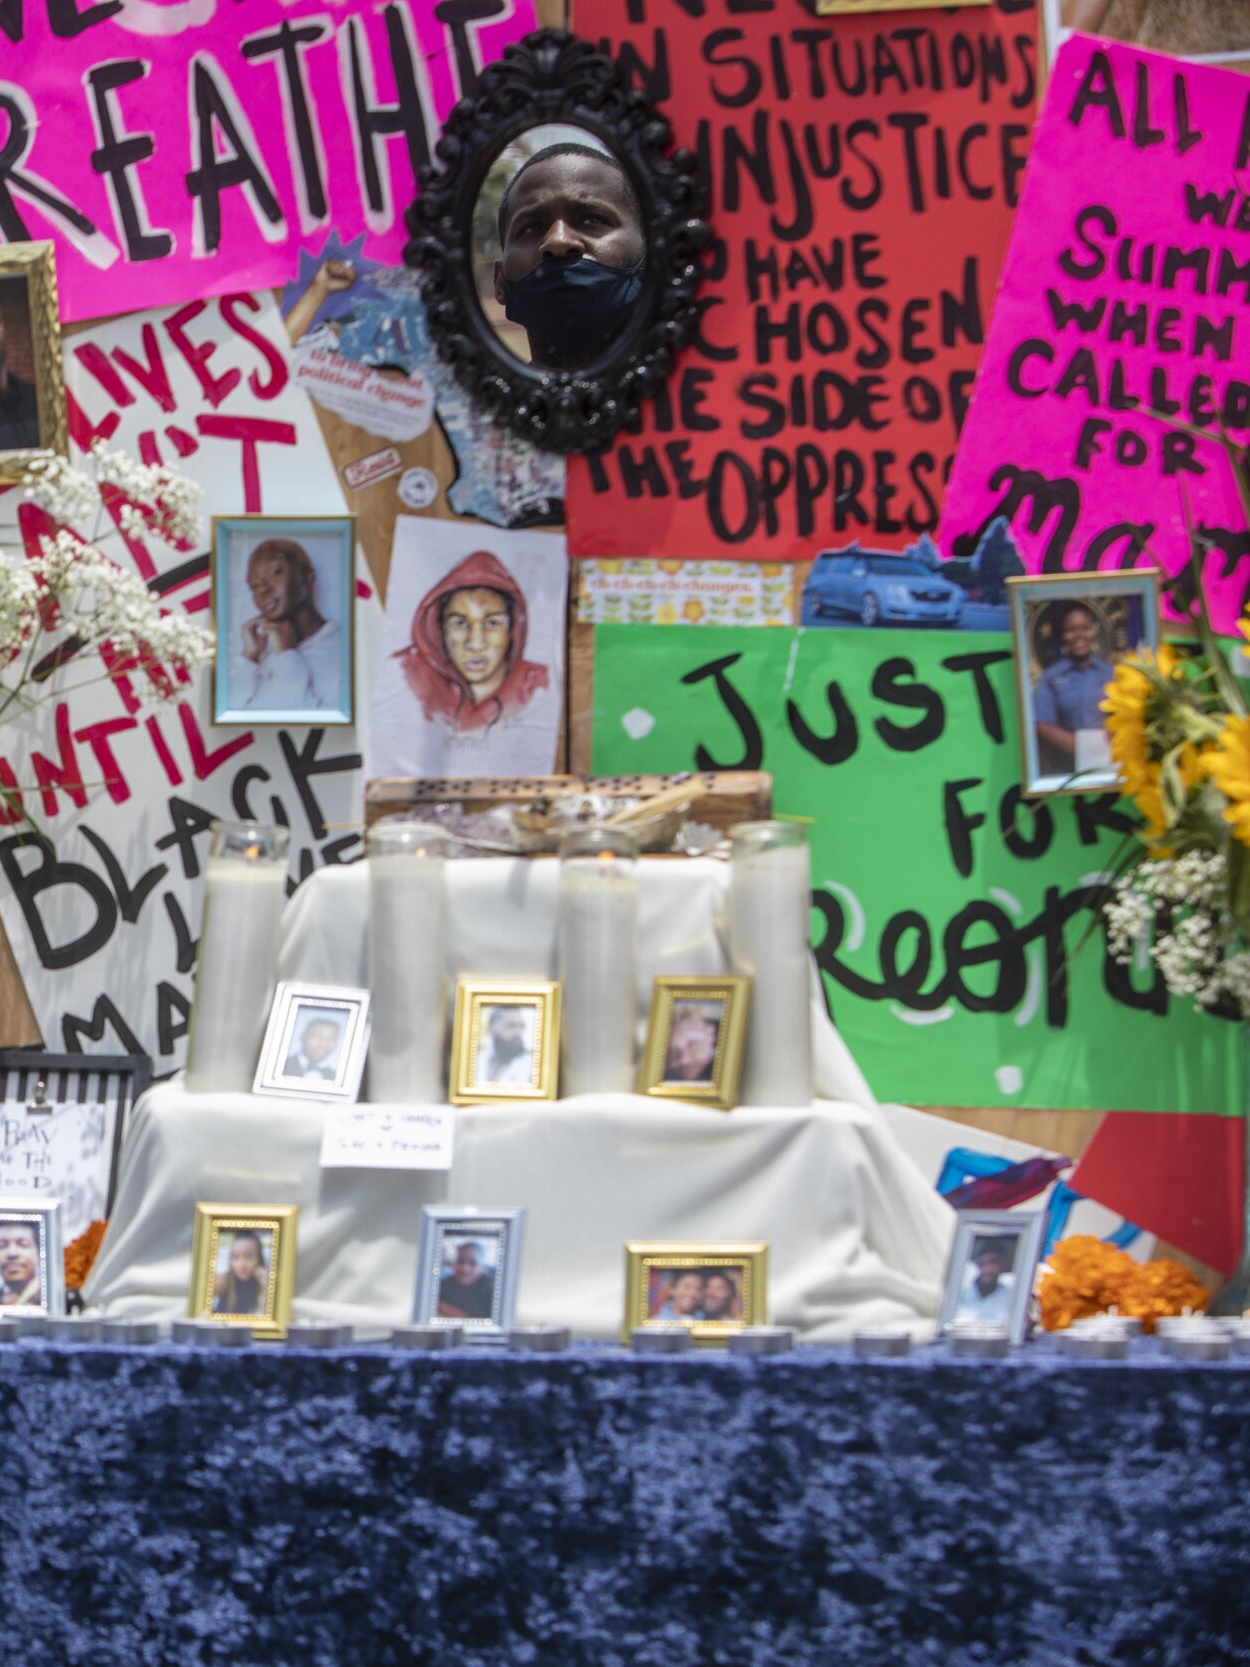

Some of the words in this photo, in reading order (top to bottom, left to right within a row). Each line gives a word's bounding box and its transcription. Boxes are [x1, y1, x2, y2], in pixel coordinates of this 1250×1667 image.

[701, 28, 1035, 108] SITUATIONS
[1068, 51, 1203, 155] ALL
[745, 232, 887, 303] HAVE
[692, 256, 985, 370] CHOSEN
[1046, 288, 1235, 361] WHEN
[736, 370, 893, 440] SIDE
[1007, 338, 1250, 429] CALLED
[1074, 417, 1207, 475] FOR
